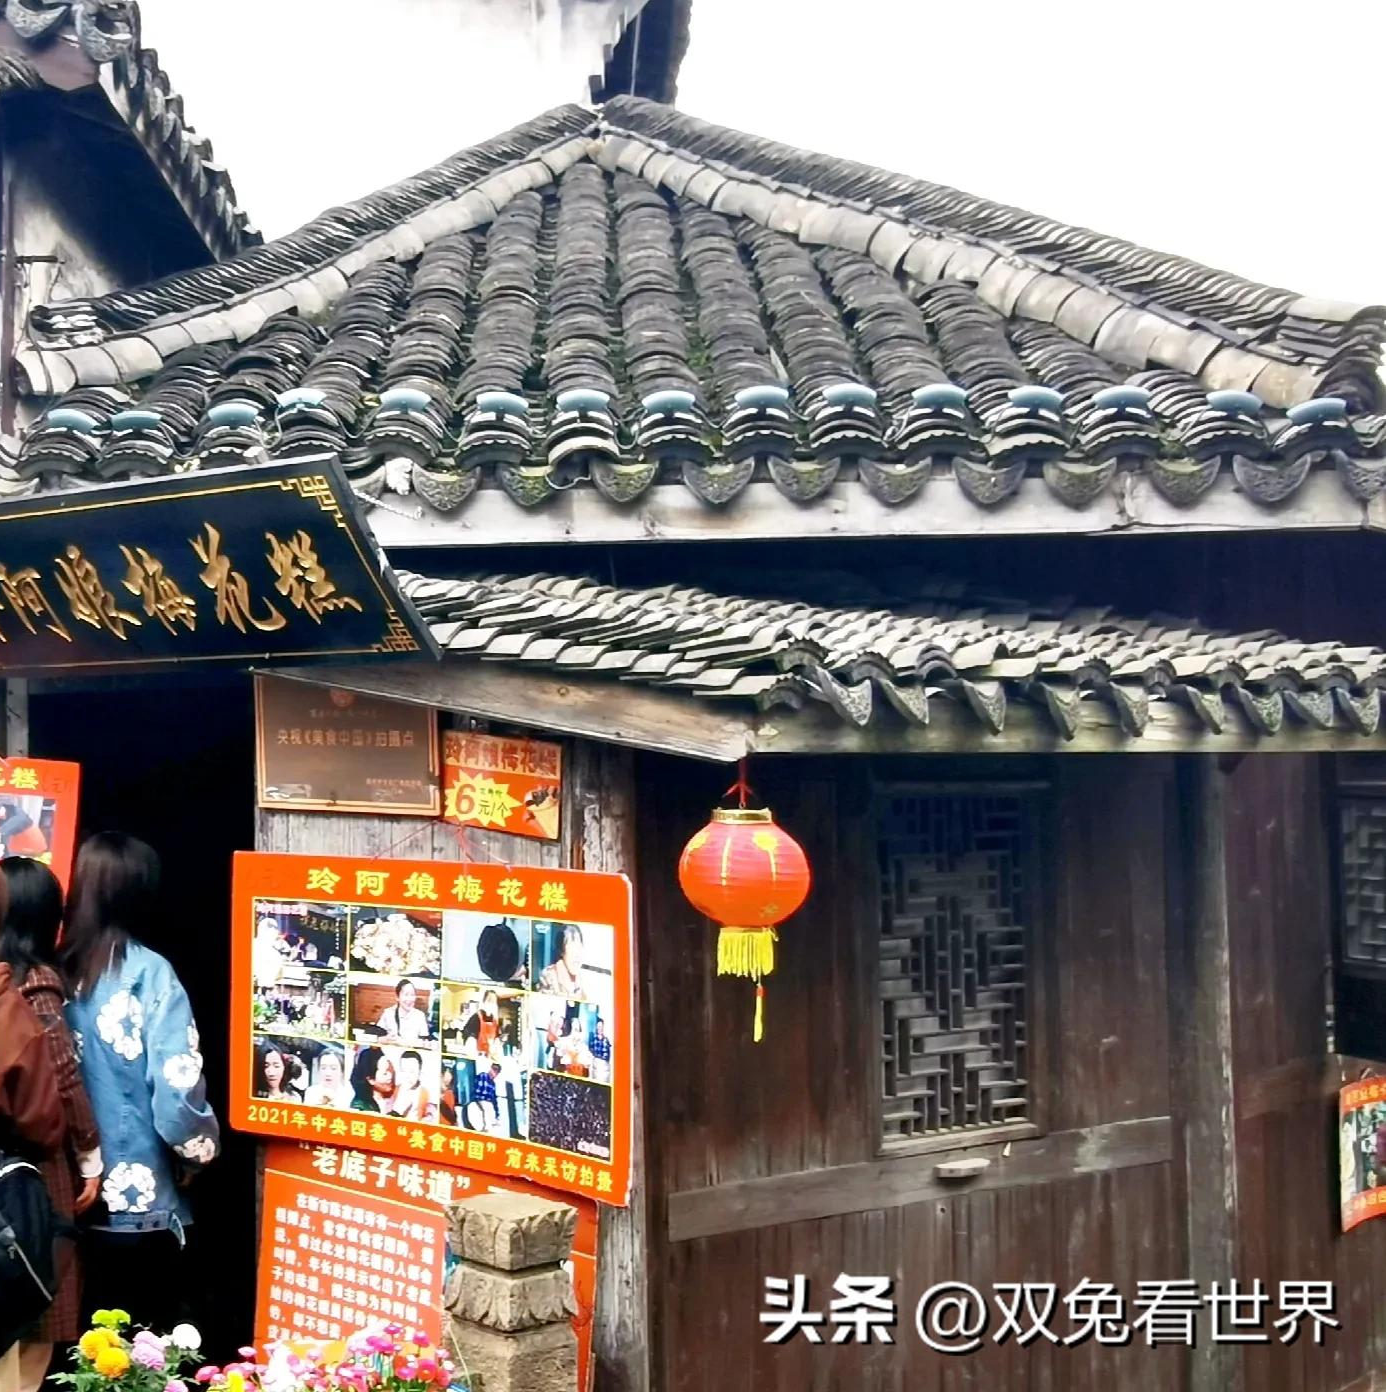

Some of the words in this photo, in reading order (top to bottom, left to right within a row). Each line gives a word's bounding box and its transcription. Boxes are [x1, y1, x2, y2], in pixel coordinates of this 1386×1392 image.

[305, 866, 570, 913] 玲阿娘梅花糕
